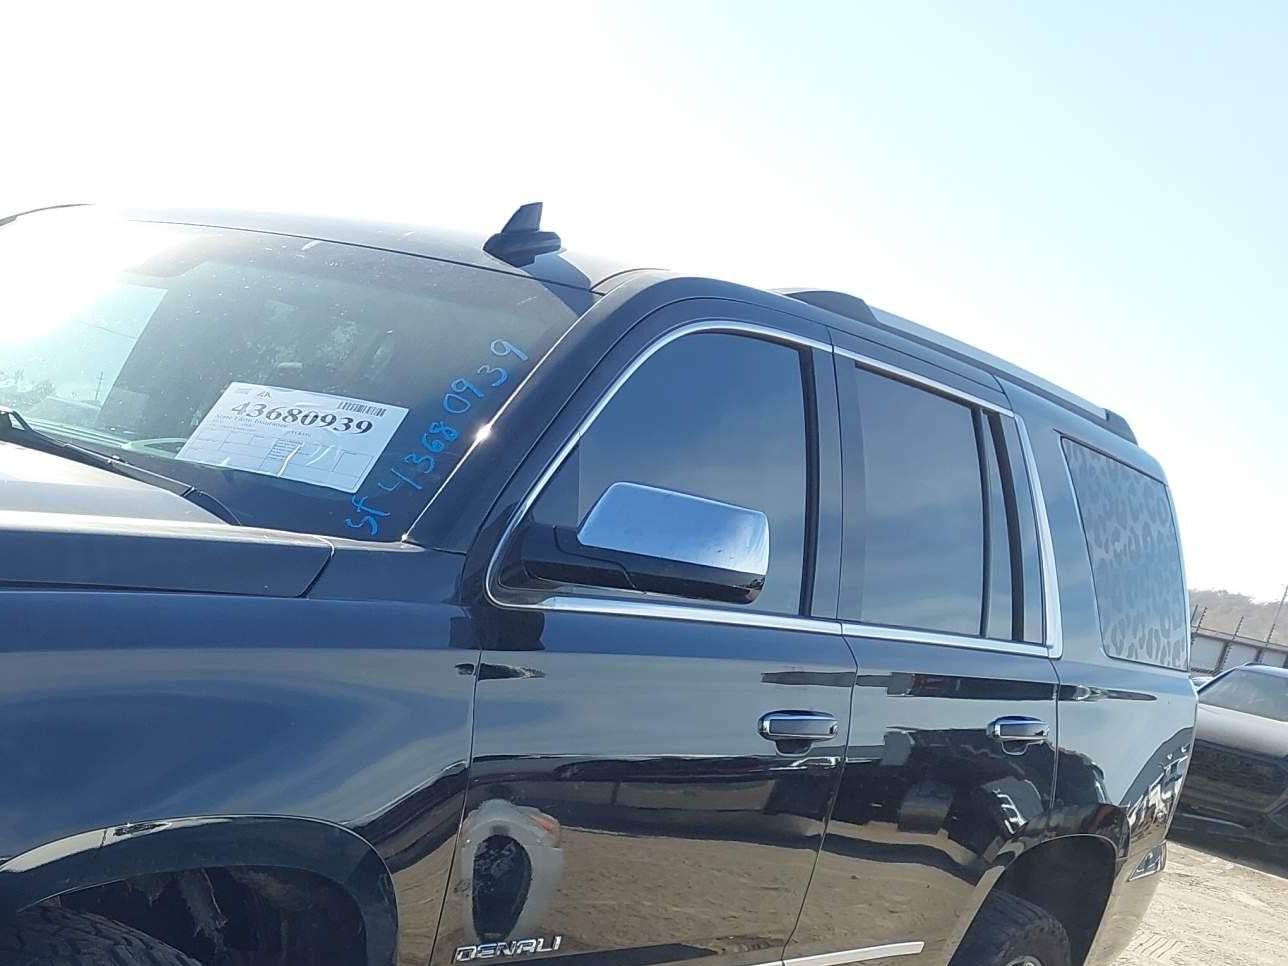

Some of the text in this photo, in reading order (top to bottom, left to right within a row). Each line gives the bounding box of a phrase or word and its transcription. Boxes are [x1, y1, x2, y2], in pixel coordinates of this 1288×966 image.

[231, 401, 373, 435] 43680939
[373, 338, 529, 492] 43680939
[454, 935, 562, 962] DENALI
